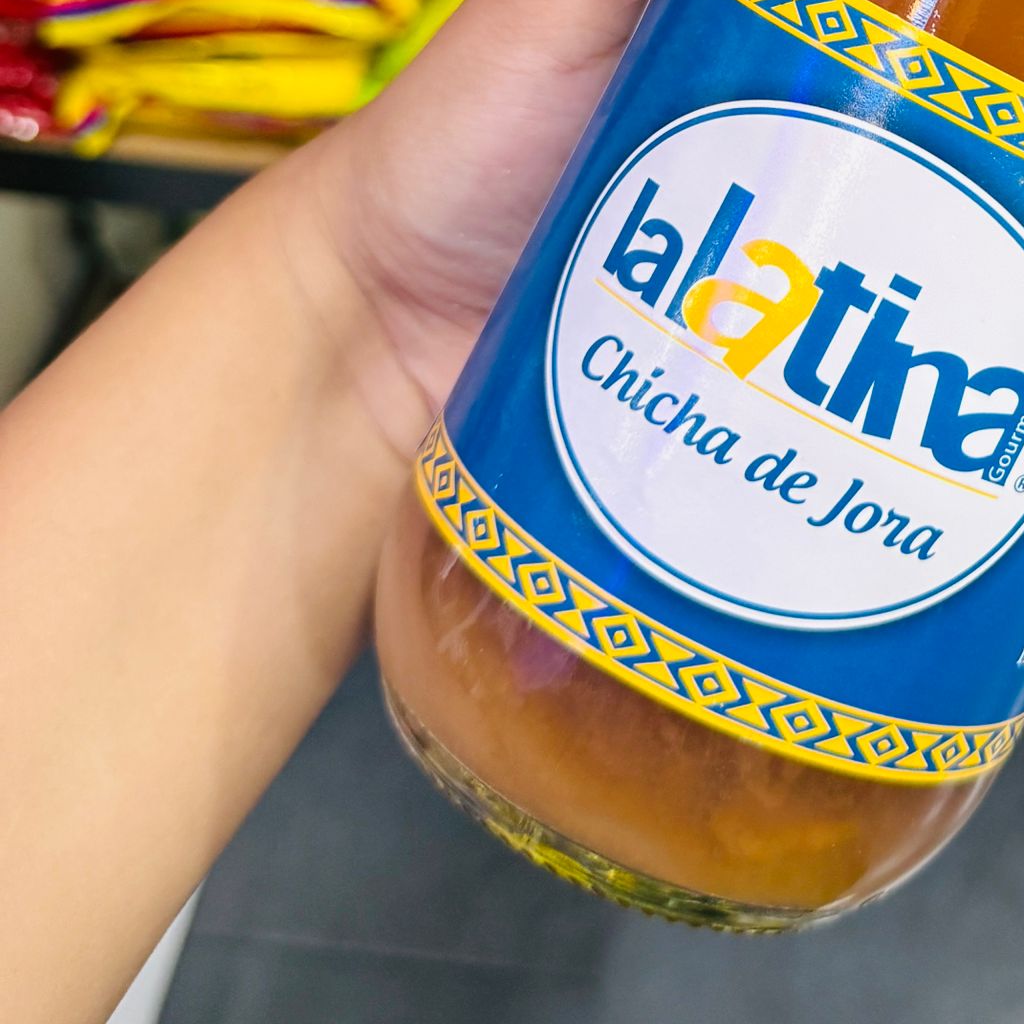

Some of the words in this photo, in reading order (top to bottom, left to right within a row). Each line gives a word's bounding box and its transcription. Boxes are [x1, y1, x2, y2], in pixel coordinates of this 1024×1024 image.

[581, 334, 742, 465] Chicha
[744, 448, 818, 504] de
[806, 478, 944, 560] Jora
